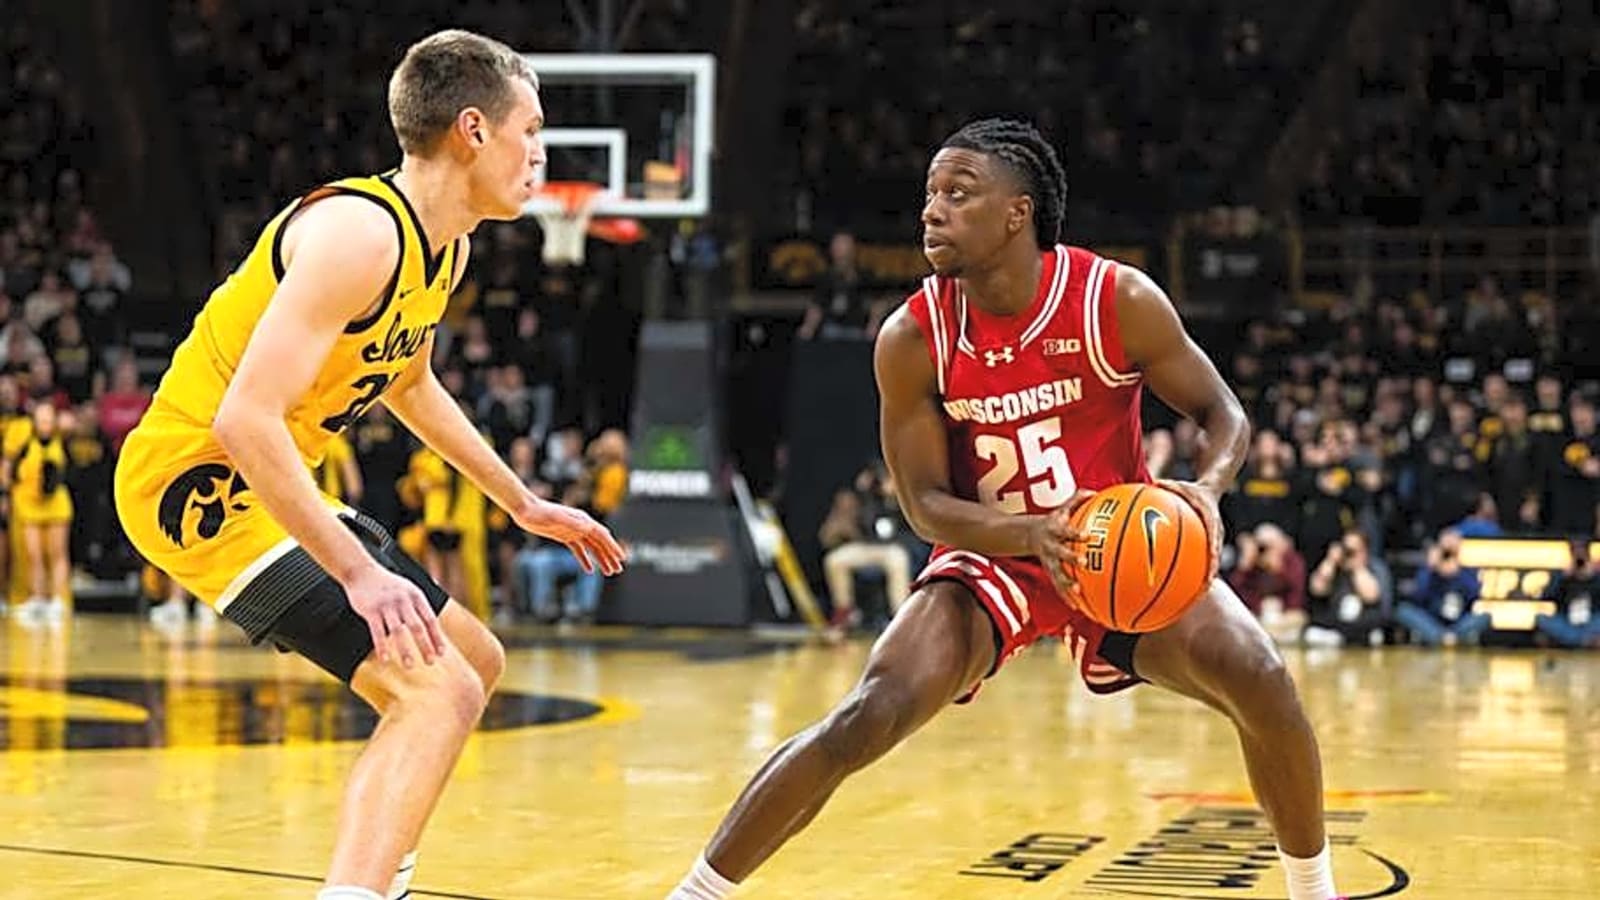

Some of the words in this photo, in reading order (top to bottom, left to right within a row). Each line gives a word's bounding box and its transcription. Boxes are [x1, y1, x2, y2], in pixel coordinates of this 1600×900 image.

[320, 372, 400, 432] 2
[943, 377, 1083, 425] WISCONSIN
[974, 416, 1078, 514] 25
[1085, 498, 1121, 572] ELITE
